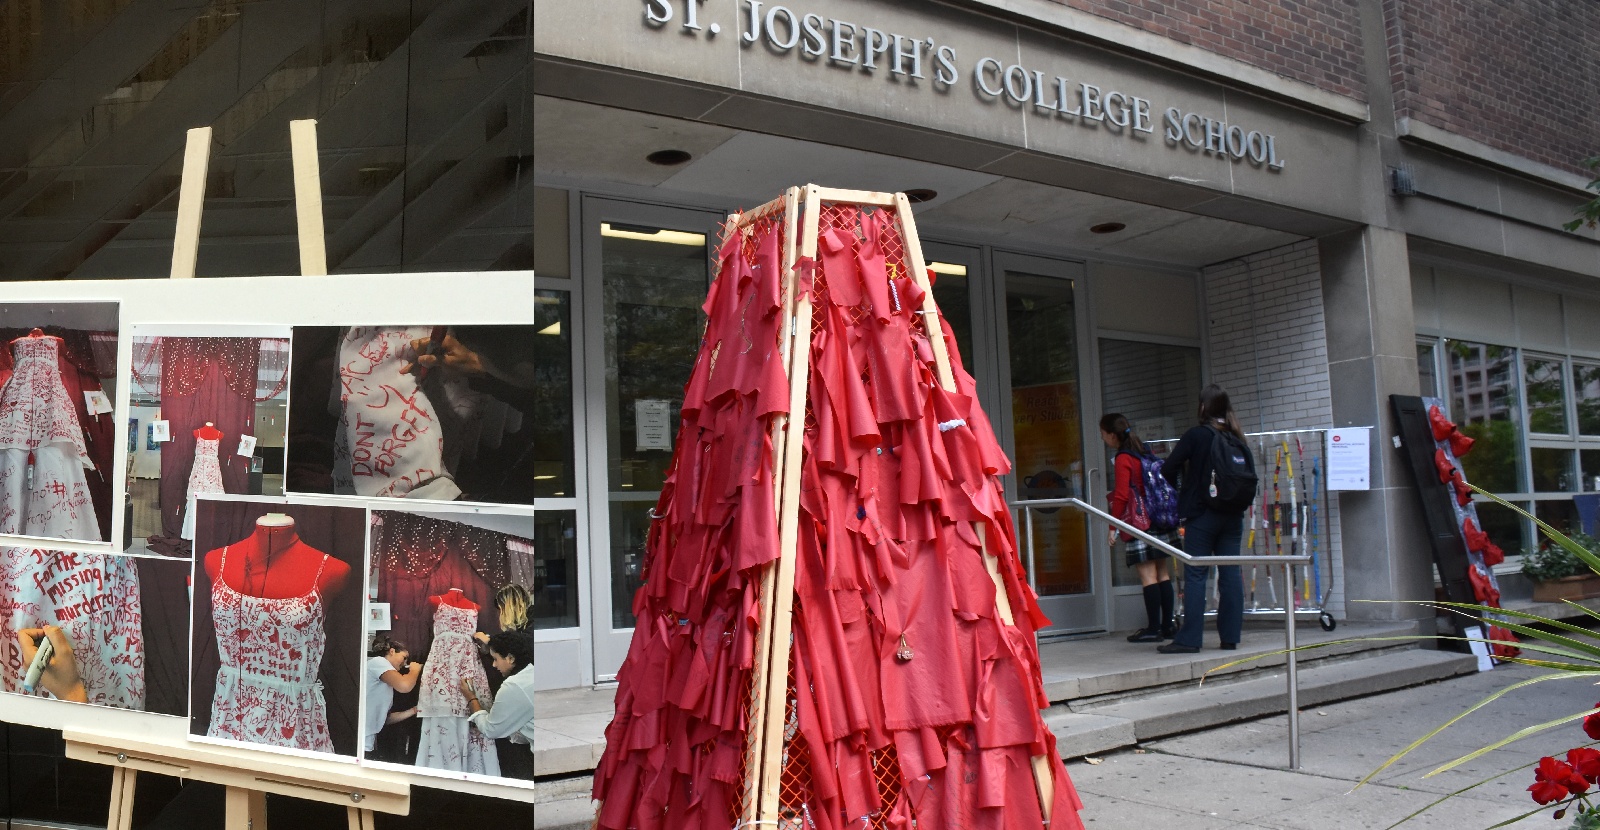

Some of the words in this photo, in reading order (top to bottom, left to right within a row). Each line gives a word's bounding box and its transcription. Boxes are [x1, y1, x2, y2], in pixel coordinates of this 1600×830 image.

[646, 0, 721, 34] ST.
[743, 2, 959, 85] JOSEPH'S
[974, 57, 1153, 133] COLLEGE
[1165, 107, 1285, 168] SCHOOL
[351, 412, 375, 477] DONT
